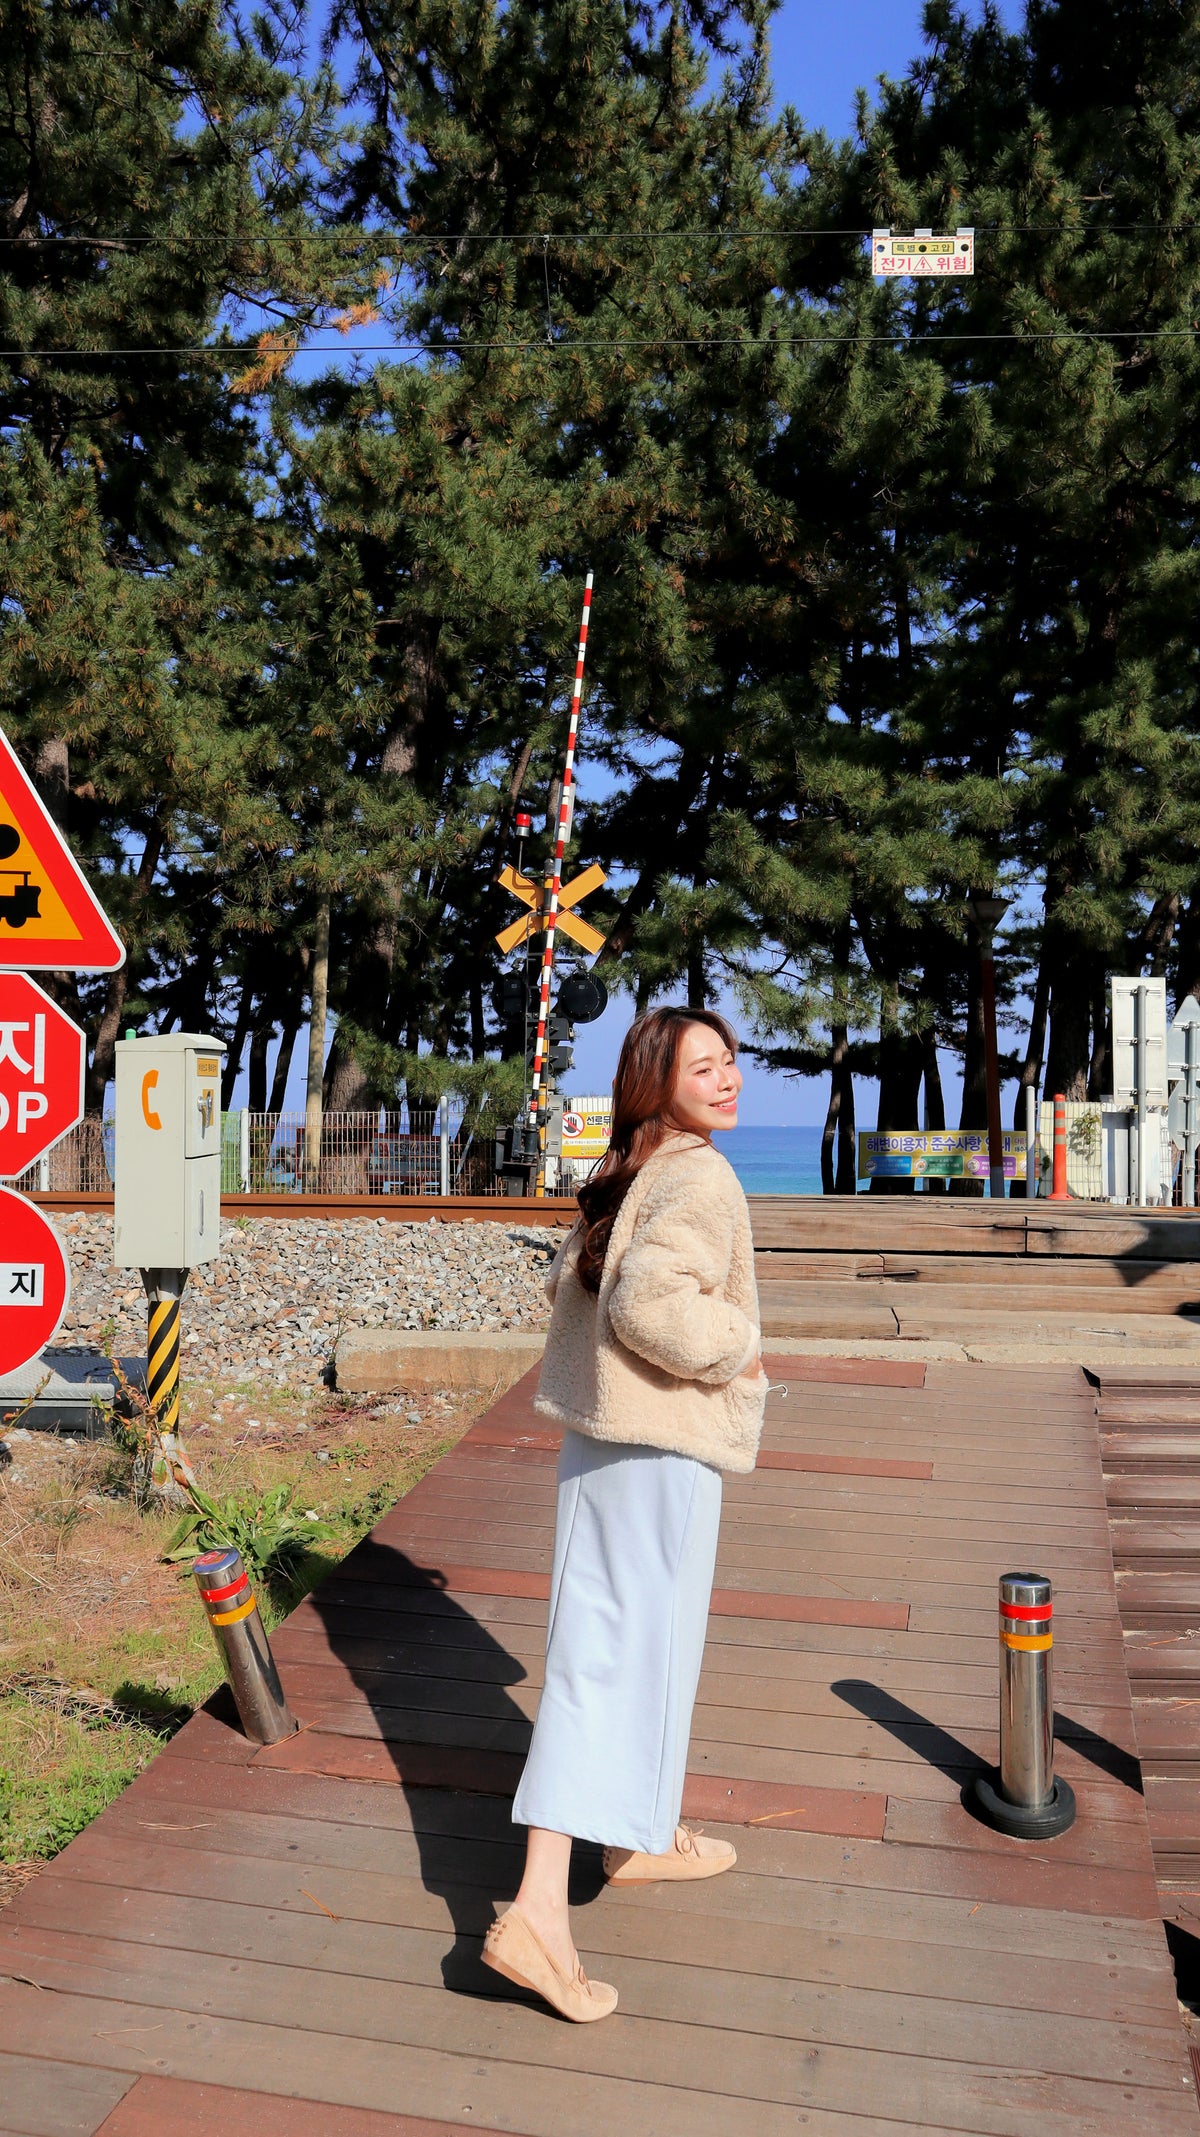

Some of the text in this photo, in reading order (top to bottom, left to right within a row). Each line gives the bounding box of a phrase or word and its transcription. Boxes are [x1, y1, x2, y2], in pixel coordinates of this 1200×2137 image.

[930, 243, 950, 252] 고압
[881, 256, 967, 270] 전기 위험
[0, 1013, 46, 1084] 지
[866, 1136, 927, 1152] 해변이용자
[931, 1136, 981, 1152] 준수사항
[9, 1269, 36, 1297] 지
